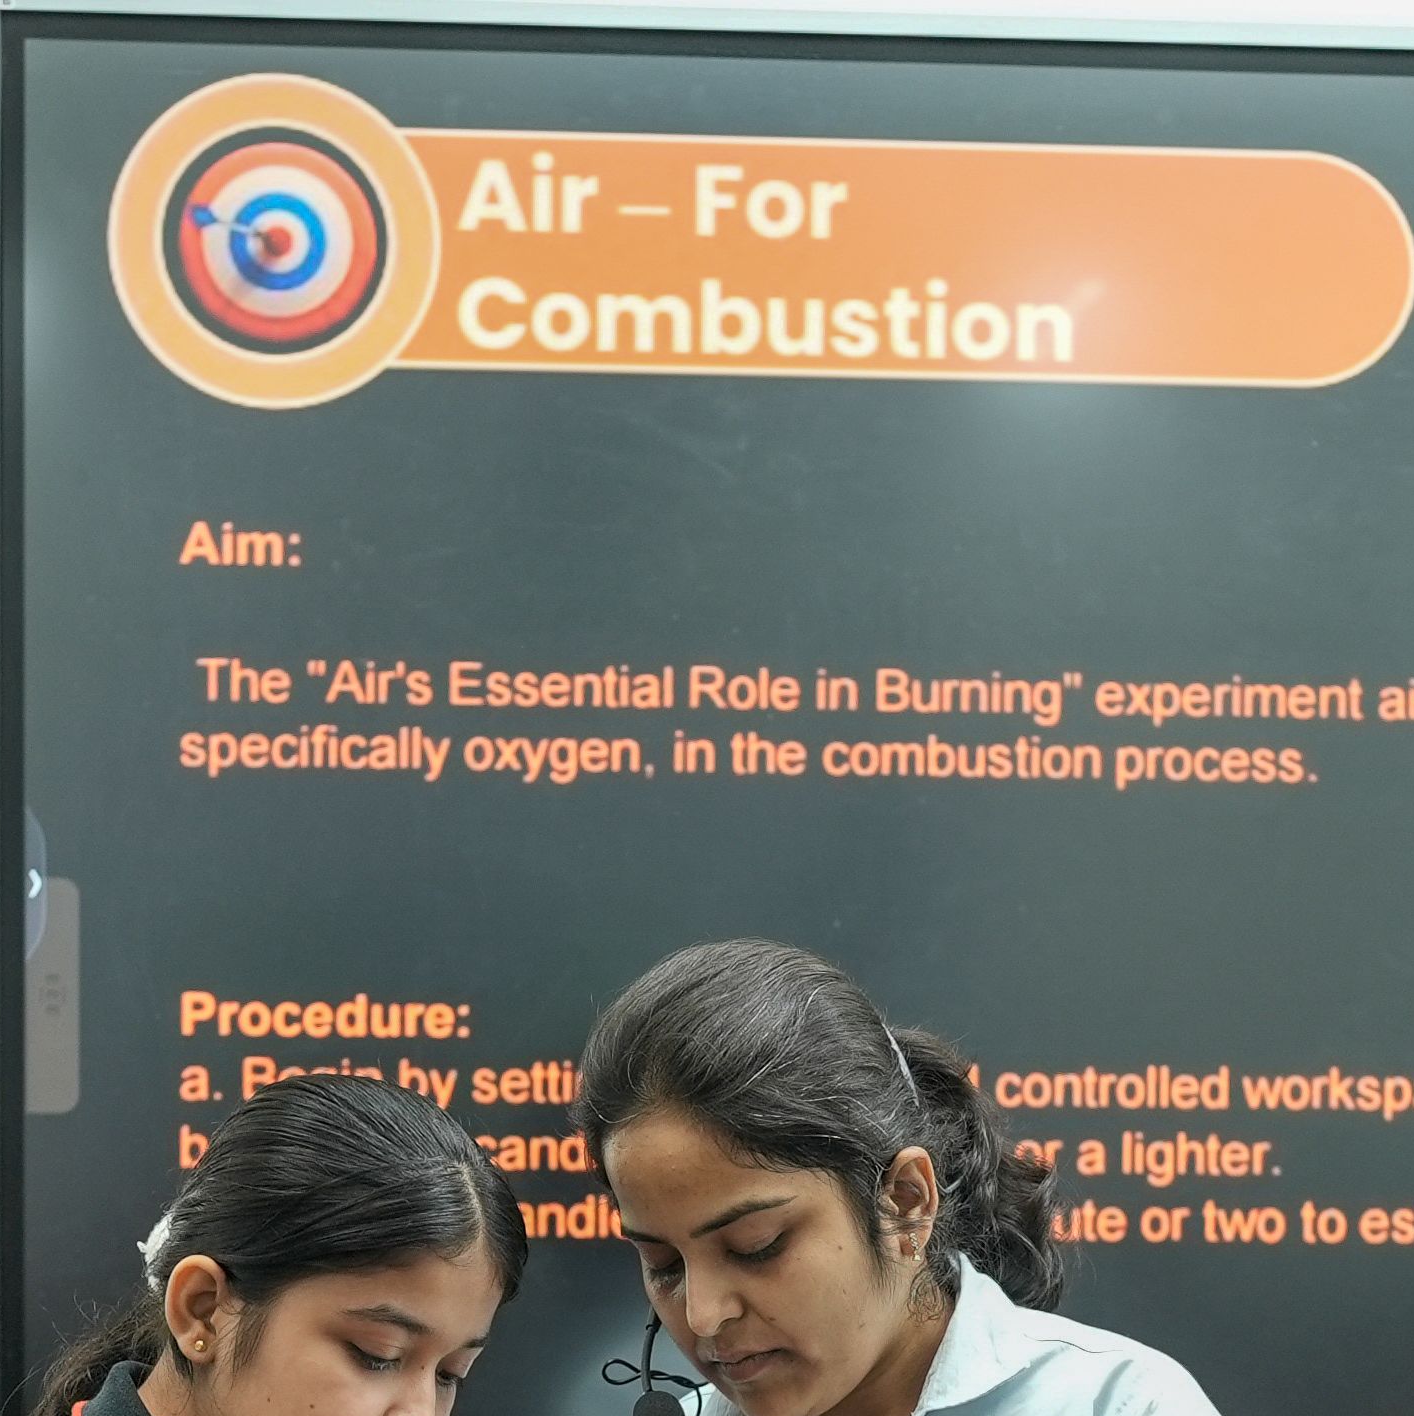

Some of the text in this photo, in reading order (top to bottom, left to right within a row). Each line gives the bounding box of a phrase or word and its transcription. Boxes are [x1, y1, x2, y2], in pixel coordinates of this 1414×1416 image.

[458, 151, 599, 233] Air
[695, 164, 848, 240] For
[457, 276, 1075, 363] Combustion
[178, 520, 301, 567] Aim:
[196, 656, 292, 705] The
[306, 659, 434, 706] "Air's
[448, 660, 675, 710] Essential
[688, 664, 802, 712] Role
[815, 668, 859, 711] in
[875, 667, 1083, 727] Burning"
[1094, 675, 1364, 727] experiment
[179, 725, 451, 782] specifically
[673, 729, 716, 774] in
[730, 731, 808, 776] the
[821, 733, 1103, 780] combustion
[1114, 745, 1318, 791] process.
[180, 990, 471, 1040] Procedure:
[179, 1064, 224, 1101] a.
[471, 1060, 583, 1104] setti
[995, 1064, 1231, 1111] controlled
[1076, 1139, 1107, 1176] a
[1121, 1130, 1281, 1188] lighter.
[1140, 1206, 1191, 1243] or
[1202, 1199, 1287, 1245] two
[1299, 1200, 1348, 1245] to
